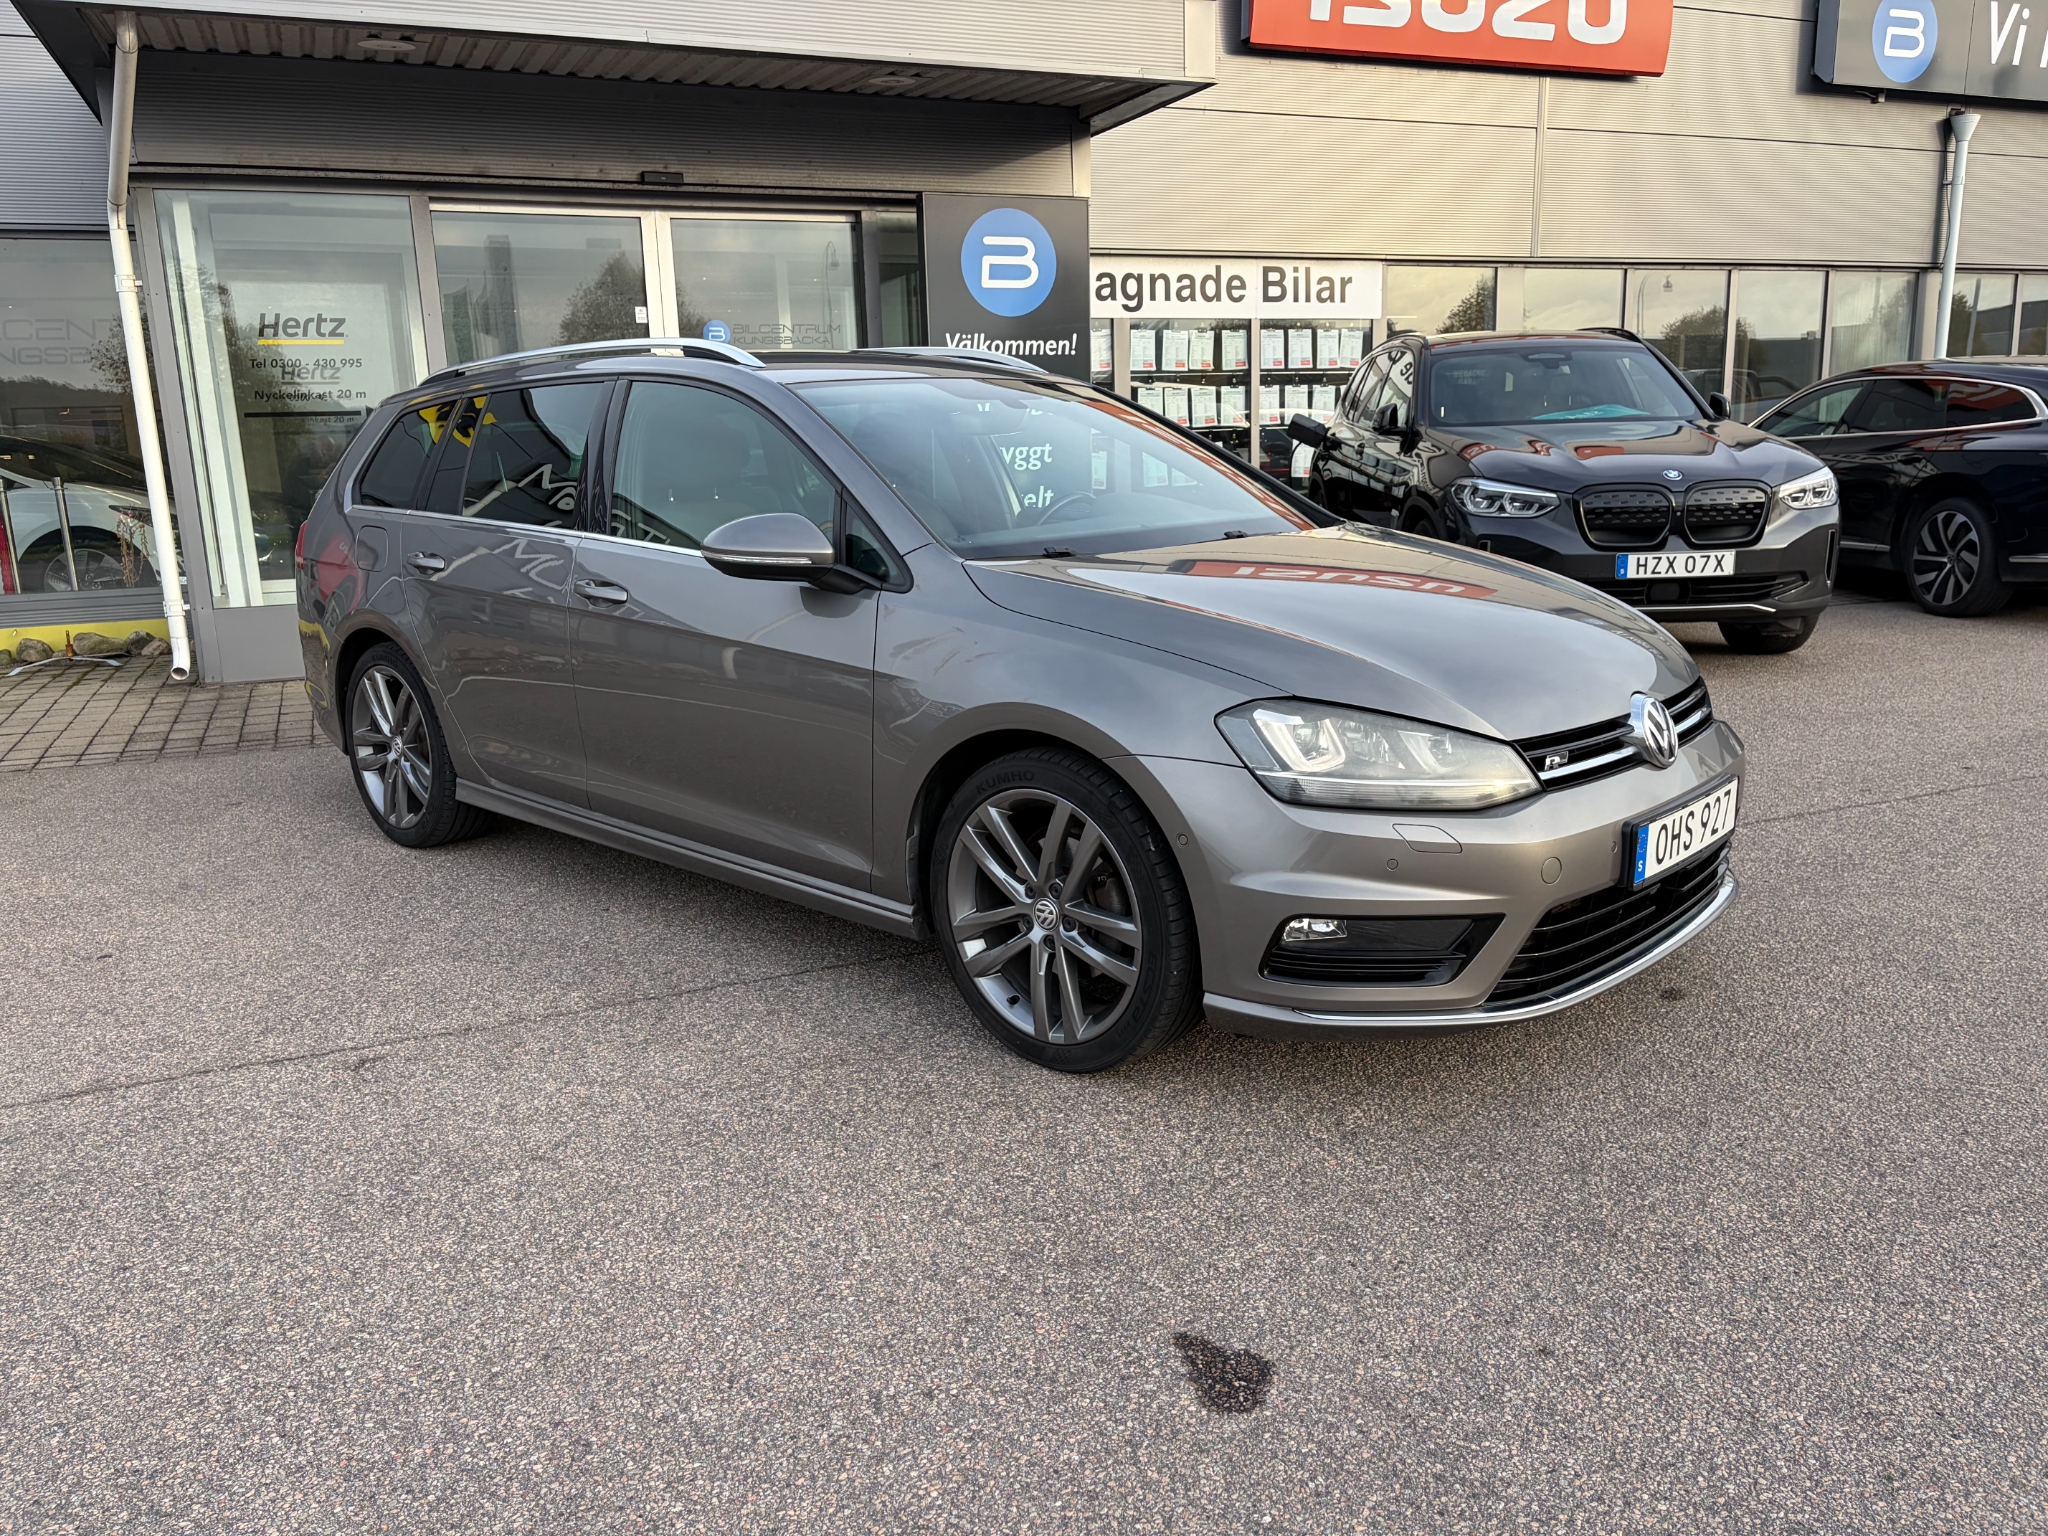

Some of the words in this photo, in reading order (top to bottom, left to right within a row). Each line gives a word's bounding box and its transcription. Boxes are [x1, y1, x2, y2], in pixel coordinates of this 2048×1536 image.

[1990, 1, 2030, 66] Vi
[1095, 264, 1247, 313] agnade
[1262, 266, 1353, 303] Bilar
[258, 313, 346, 338] Hertz
[733, 323, 841, 334] BILCENTRUM
[734, 336, 830, 345] KUNGSBACKA
[945, 332, 1077, 356] Välkommen!
[249, 358, 267, 369] Tel
[270, 358, 302, 369] 0300
[313, 358, 336, 368] 430
[340, 358, 363, 368] 995
[254, 389, 333, 403] Nyckelinkast
[336, 389, 352, 399] 20
[355, 391, 367, 399] m
[1021, 485, 1054, 508] elt
[1636, 556, 1677, 575] HZX
[1685, 554, 1725, 574] 07X
[976, 770, 1035, 795] KUMHO
[1655, 810, 1695, 865] OHS
[1700, 788, 1732, 844] 927
[1637, 860, 1643, 872] S
